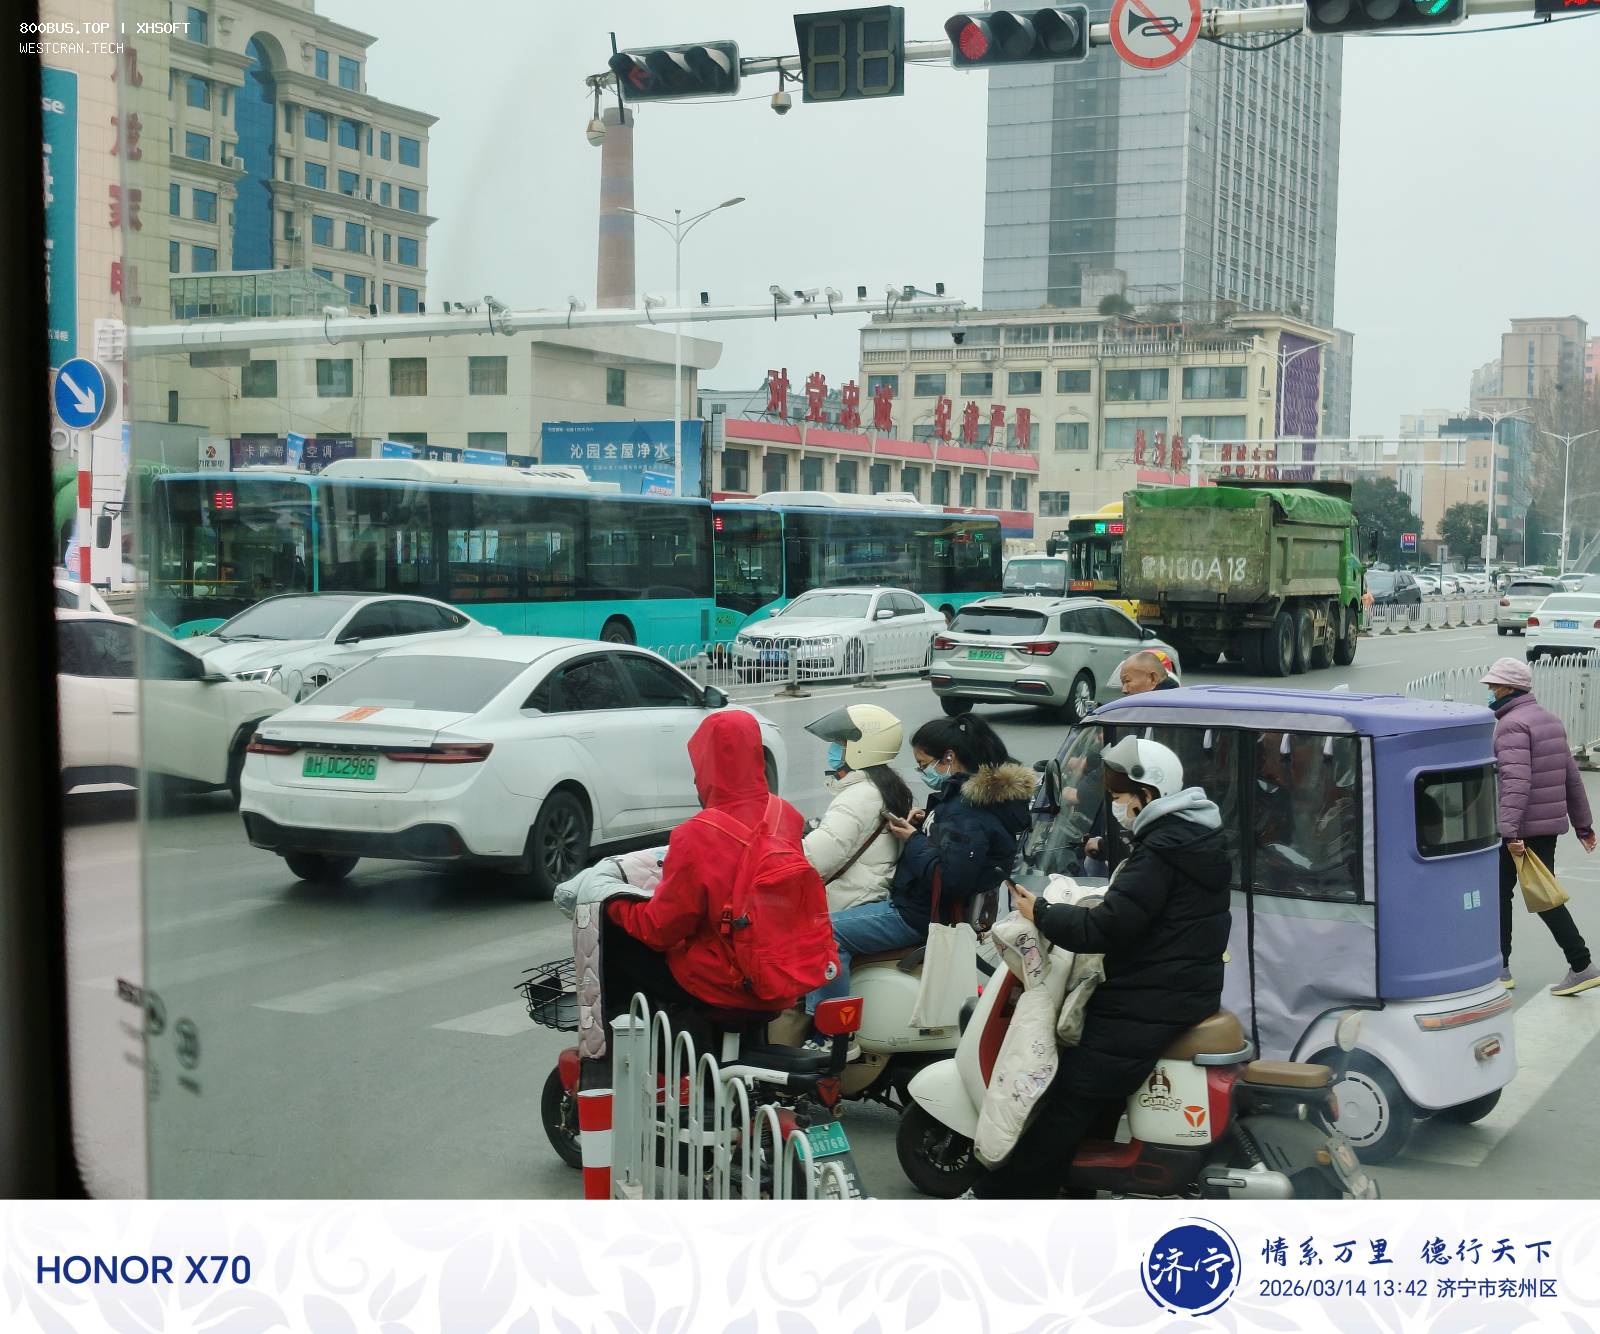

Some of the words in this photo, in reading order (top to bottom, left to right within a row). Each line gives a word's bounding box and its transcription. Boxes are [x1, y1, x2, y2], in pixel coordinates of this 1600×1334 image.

[570, 442, 670, 460] 沁园全屋净水
